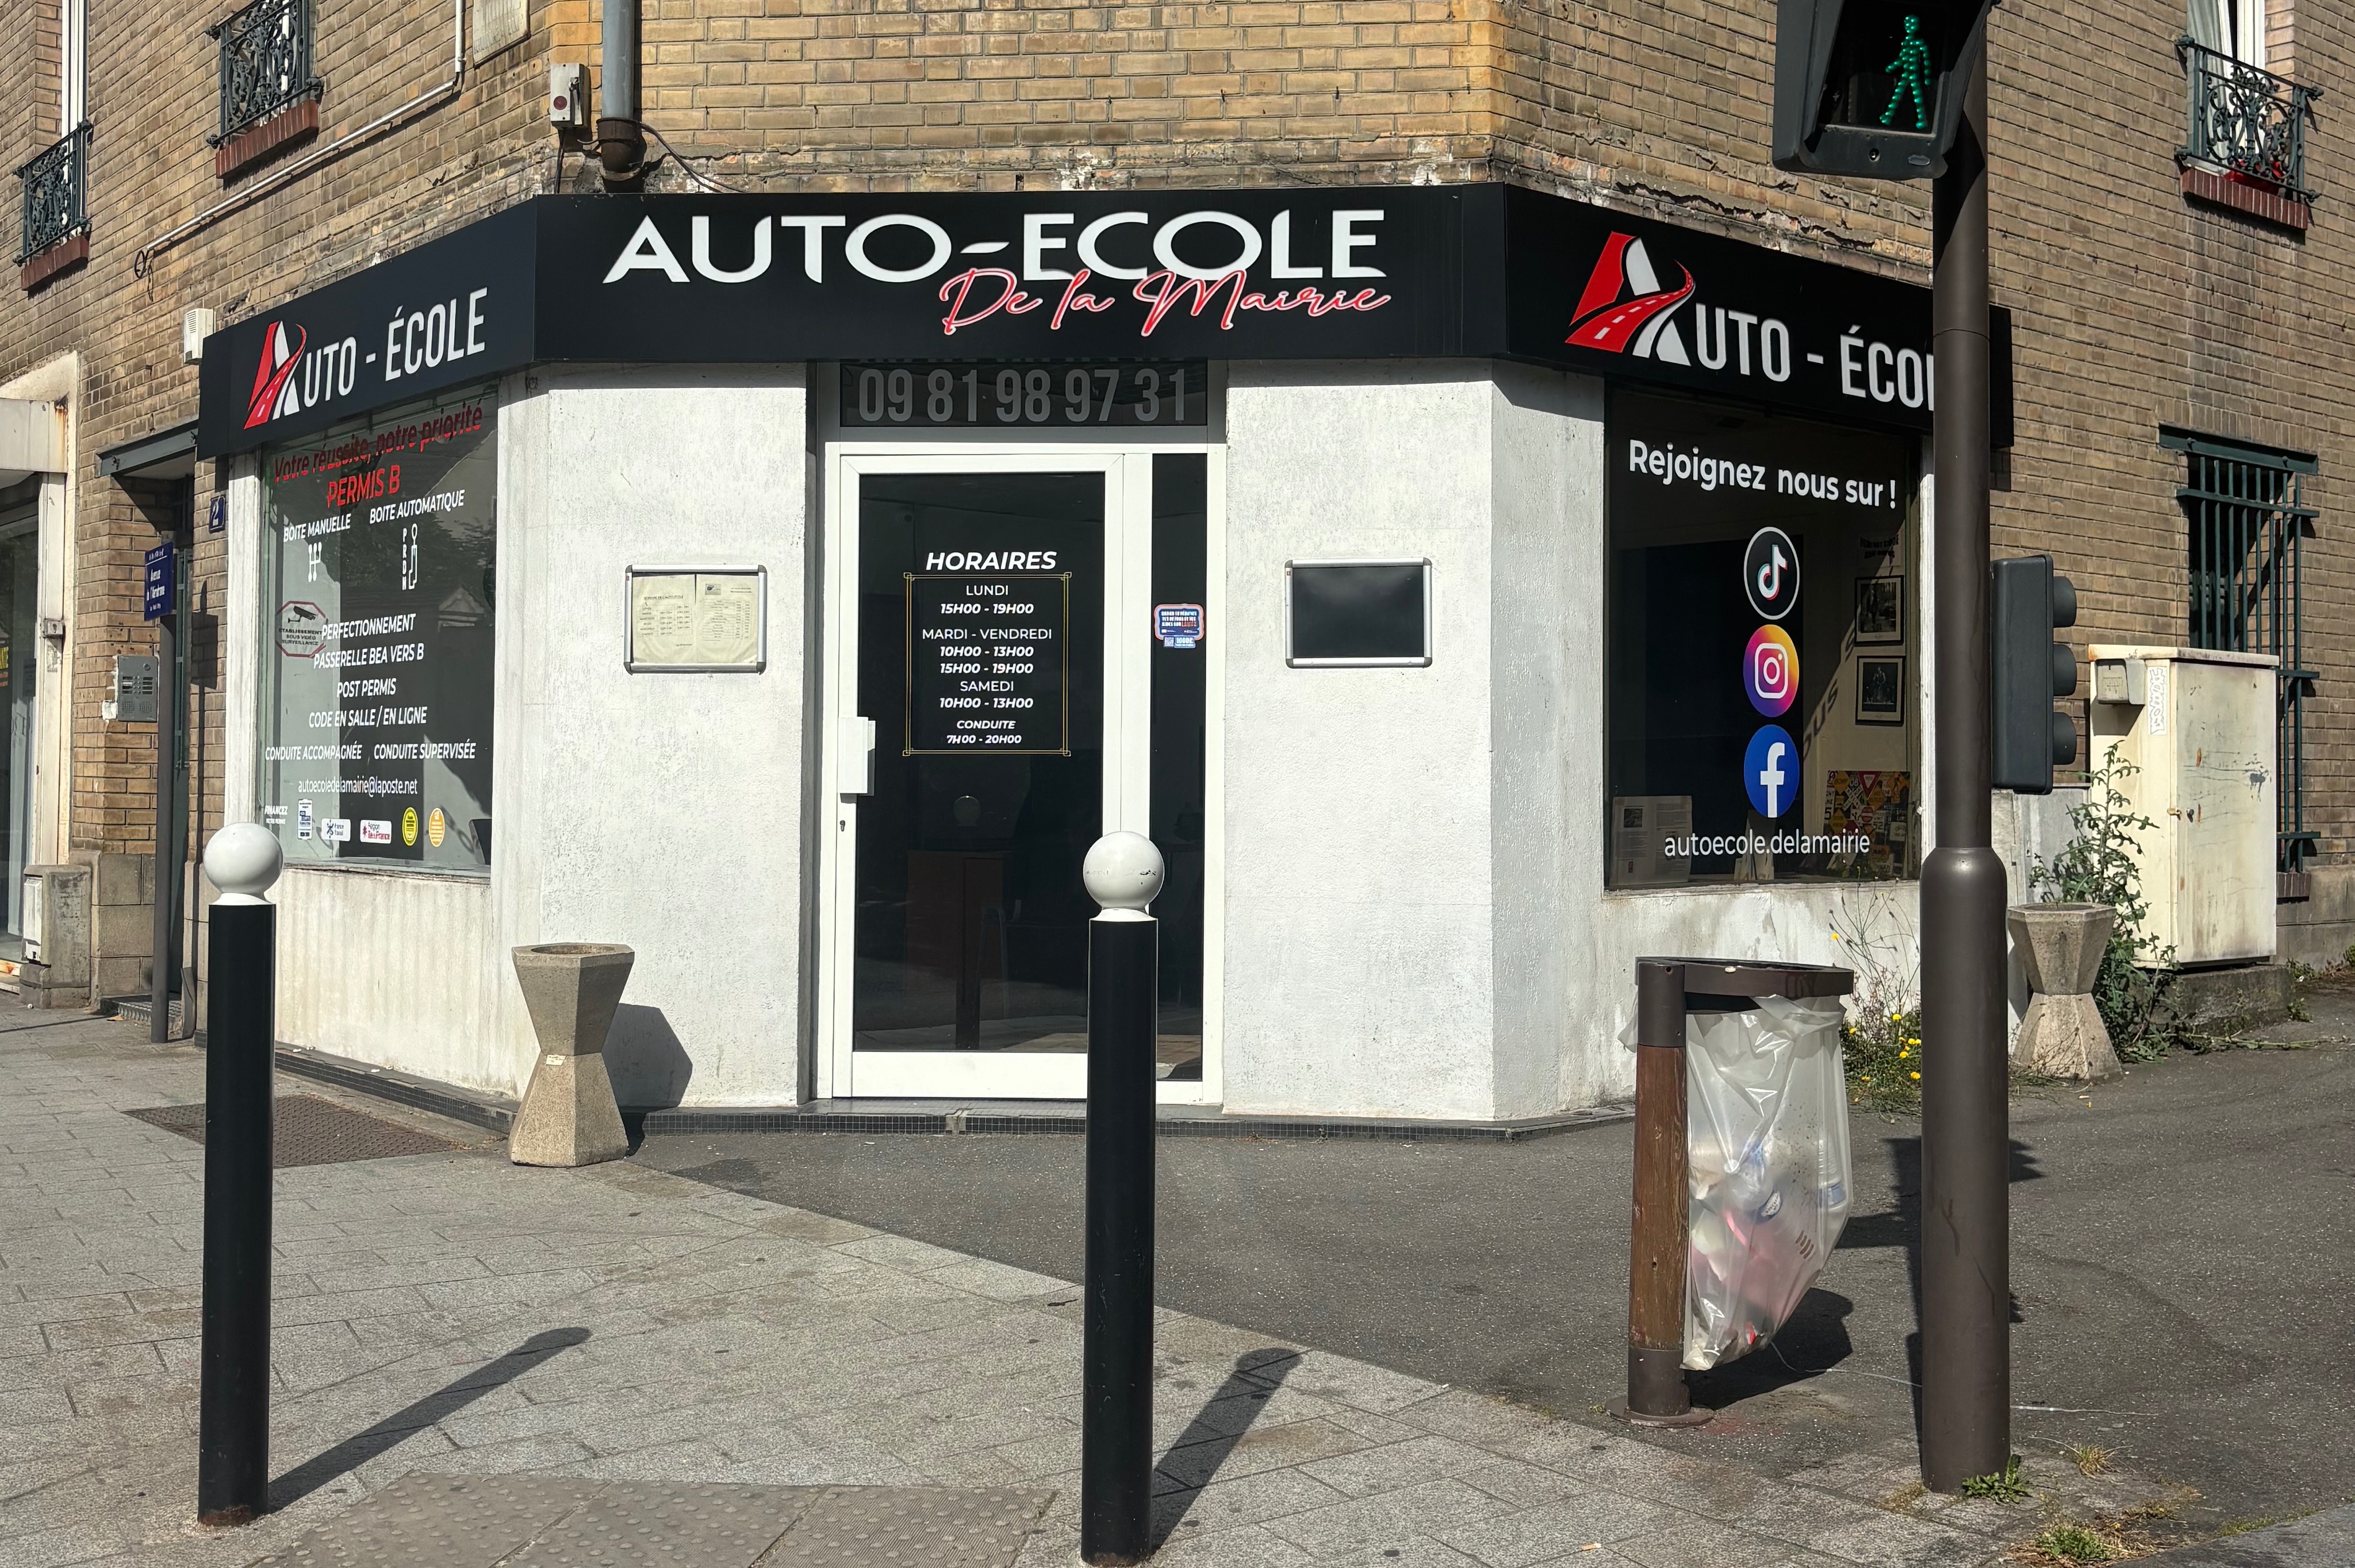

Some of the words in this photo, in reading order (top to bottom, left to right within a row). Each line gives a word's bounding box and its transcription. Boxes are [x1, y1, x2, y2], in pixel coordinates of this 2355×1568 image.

[603, 209, 1386, 285] AUTO-ECOLE
[939, 267, 1044, 335] De
[1049, 268, 1115, 330] la
[1132, 268, 1391, 337] Mairie
[385, 287, 488, 382] ÉCOLE
[1840, 324, 1934, 412] ÉCO
[859, 368, 913, 422] 09
[927, 368, 978, 422] 81
[996, 368, 1051, 422] 98
[1065, 368, 1120, 422] 97
[1134, 368, 1186, 422] 31
[274, 453, 310, 483] Votre
[313, 433, 371, 474] réussite,
[375, 424, 418, 456] notre
[420, 398, 483, 453] priorité
[1629, 439, 1766, 491] Rejoignez
[1777, 468, 1839, 501] nous
[1845, 479, 1884, 508] sur
[327, 468, 385, 508] PERMIS
[388, 464, 401, 495] B
[211, 499, 220, 527] 2
[370, 506, 396, 524] BOITE
[397, 489, 466, 519] AUTOMATIQUE
[283, 524, 306, 543] BOITE
[307, 513, 351, 538] MANUELLE
[925, 551, 1057, 571] HORAIRES
[966, 585, 1008, 595] LUNDI
[940, 604, 981, 614] 15H00
[993, 604, 1034, 614] 19H00
[321, 613, 416, 640] PERFECTIONNEMENT
[922, 629, 967, 639] MARDI
[980, 629, 1052, 639] VENDREDI
[313, 647, 367, 669] PASSERELLE
[369, 646, 388, 664] BEA
[390, 644, 415, 663] VERS
[416, 643, 424, 660] B
[940, 646, 981, 656] 10H00
[993, 646, 1034, 656] 13H00
[940, 663, 981, 674] 15H00
[992, 663, 1034, 674] 19H00
[336, 680, 360, 698] POST
[360, 678, 397, 697] PERMIS
[960, 681, 1014, 691] SAMEDI
[939, 698, 981, 708] 10H00
[993, 698, 1034, 708] 13H00
[309, 712, 332, 728] CODE
[334, 710, 346, 727] EN
[347, 708, 375, 727] SALLE
[383, 708, 397, 725] EN
[398, 706, 428, 725] LIGNE
[956, 720, 1016, 729] CONDUITE
[265, 745, 301, 760] CONDUITE
[302, 740, 363, 760] ACCOMPAGNÉE
[374, 743, 419, 760] CONDUITE
[419, 739, 477, 760] SUPERVISÉE
[946, 735, 976, 744] 7H00
[985, 735, 1022, 744] 20H00
[298, 774, 418, 798] autoecoledelamairie@laposte.net
[1664, 828, 1870, 858] autoecole.delamairie
